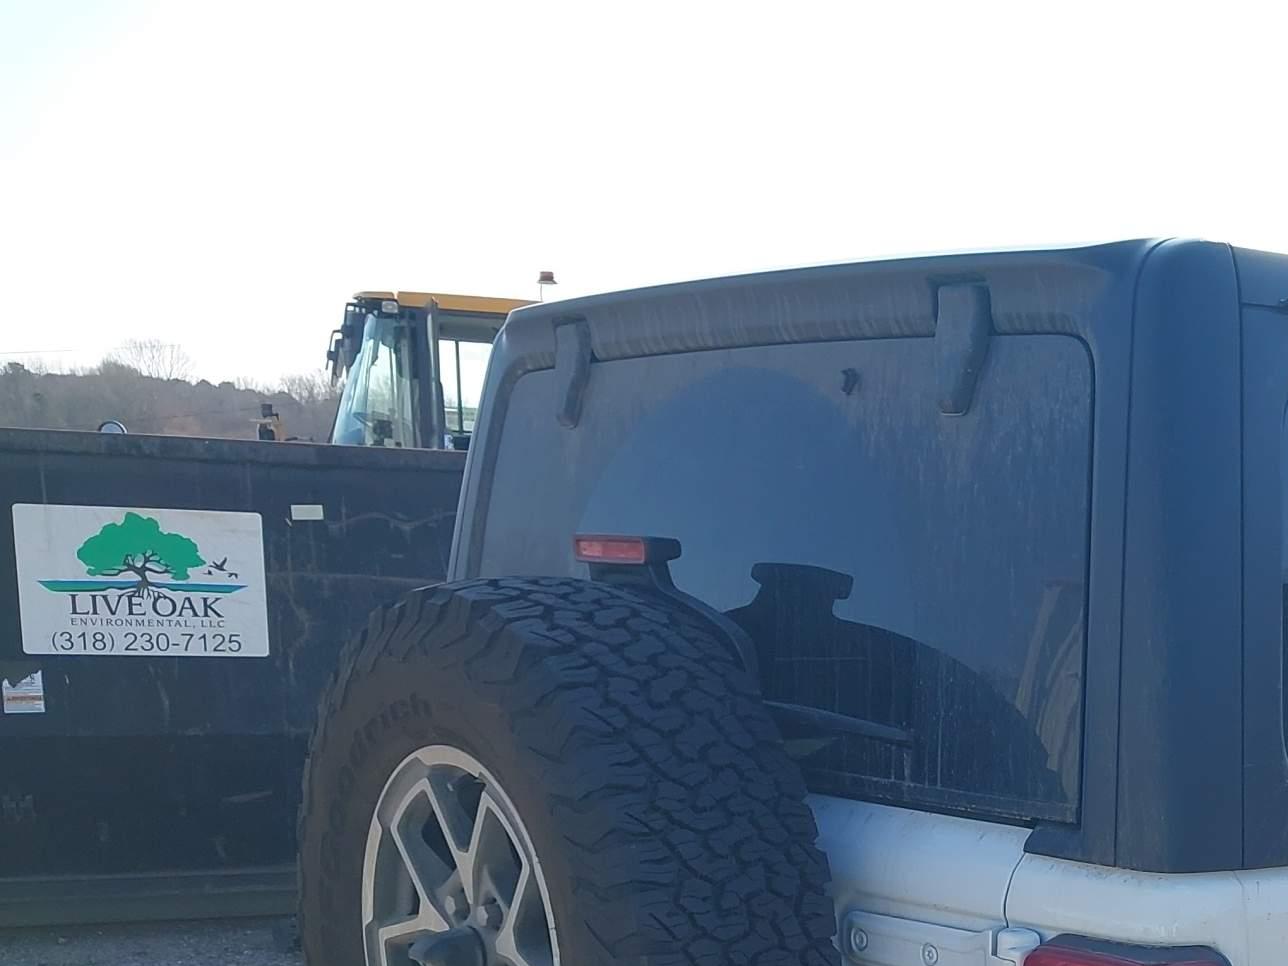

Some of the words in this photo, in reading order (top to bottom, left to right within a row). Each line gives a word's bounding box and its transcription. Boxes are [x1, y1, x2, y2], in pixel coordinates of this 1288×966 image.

[69, 593, 146, 616] LIVE
[152, 595, 224, 618] OAK
[71, 617, 196, 629] ENVIRONMENTAL,
[201, 619, 225, 629] LLC
[51, 631, 115, 652] (318)
[123, 632, 242, 653] 230-7125
